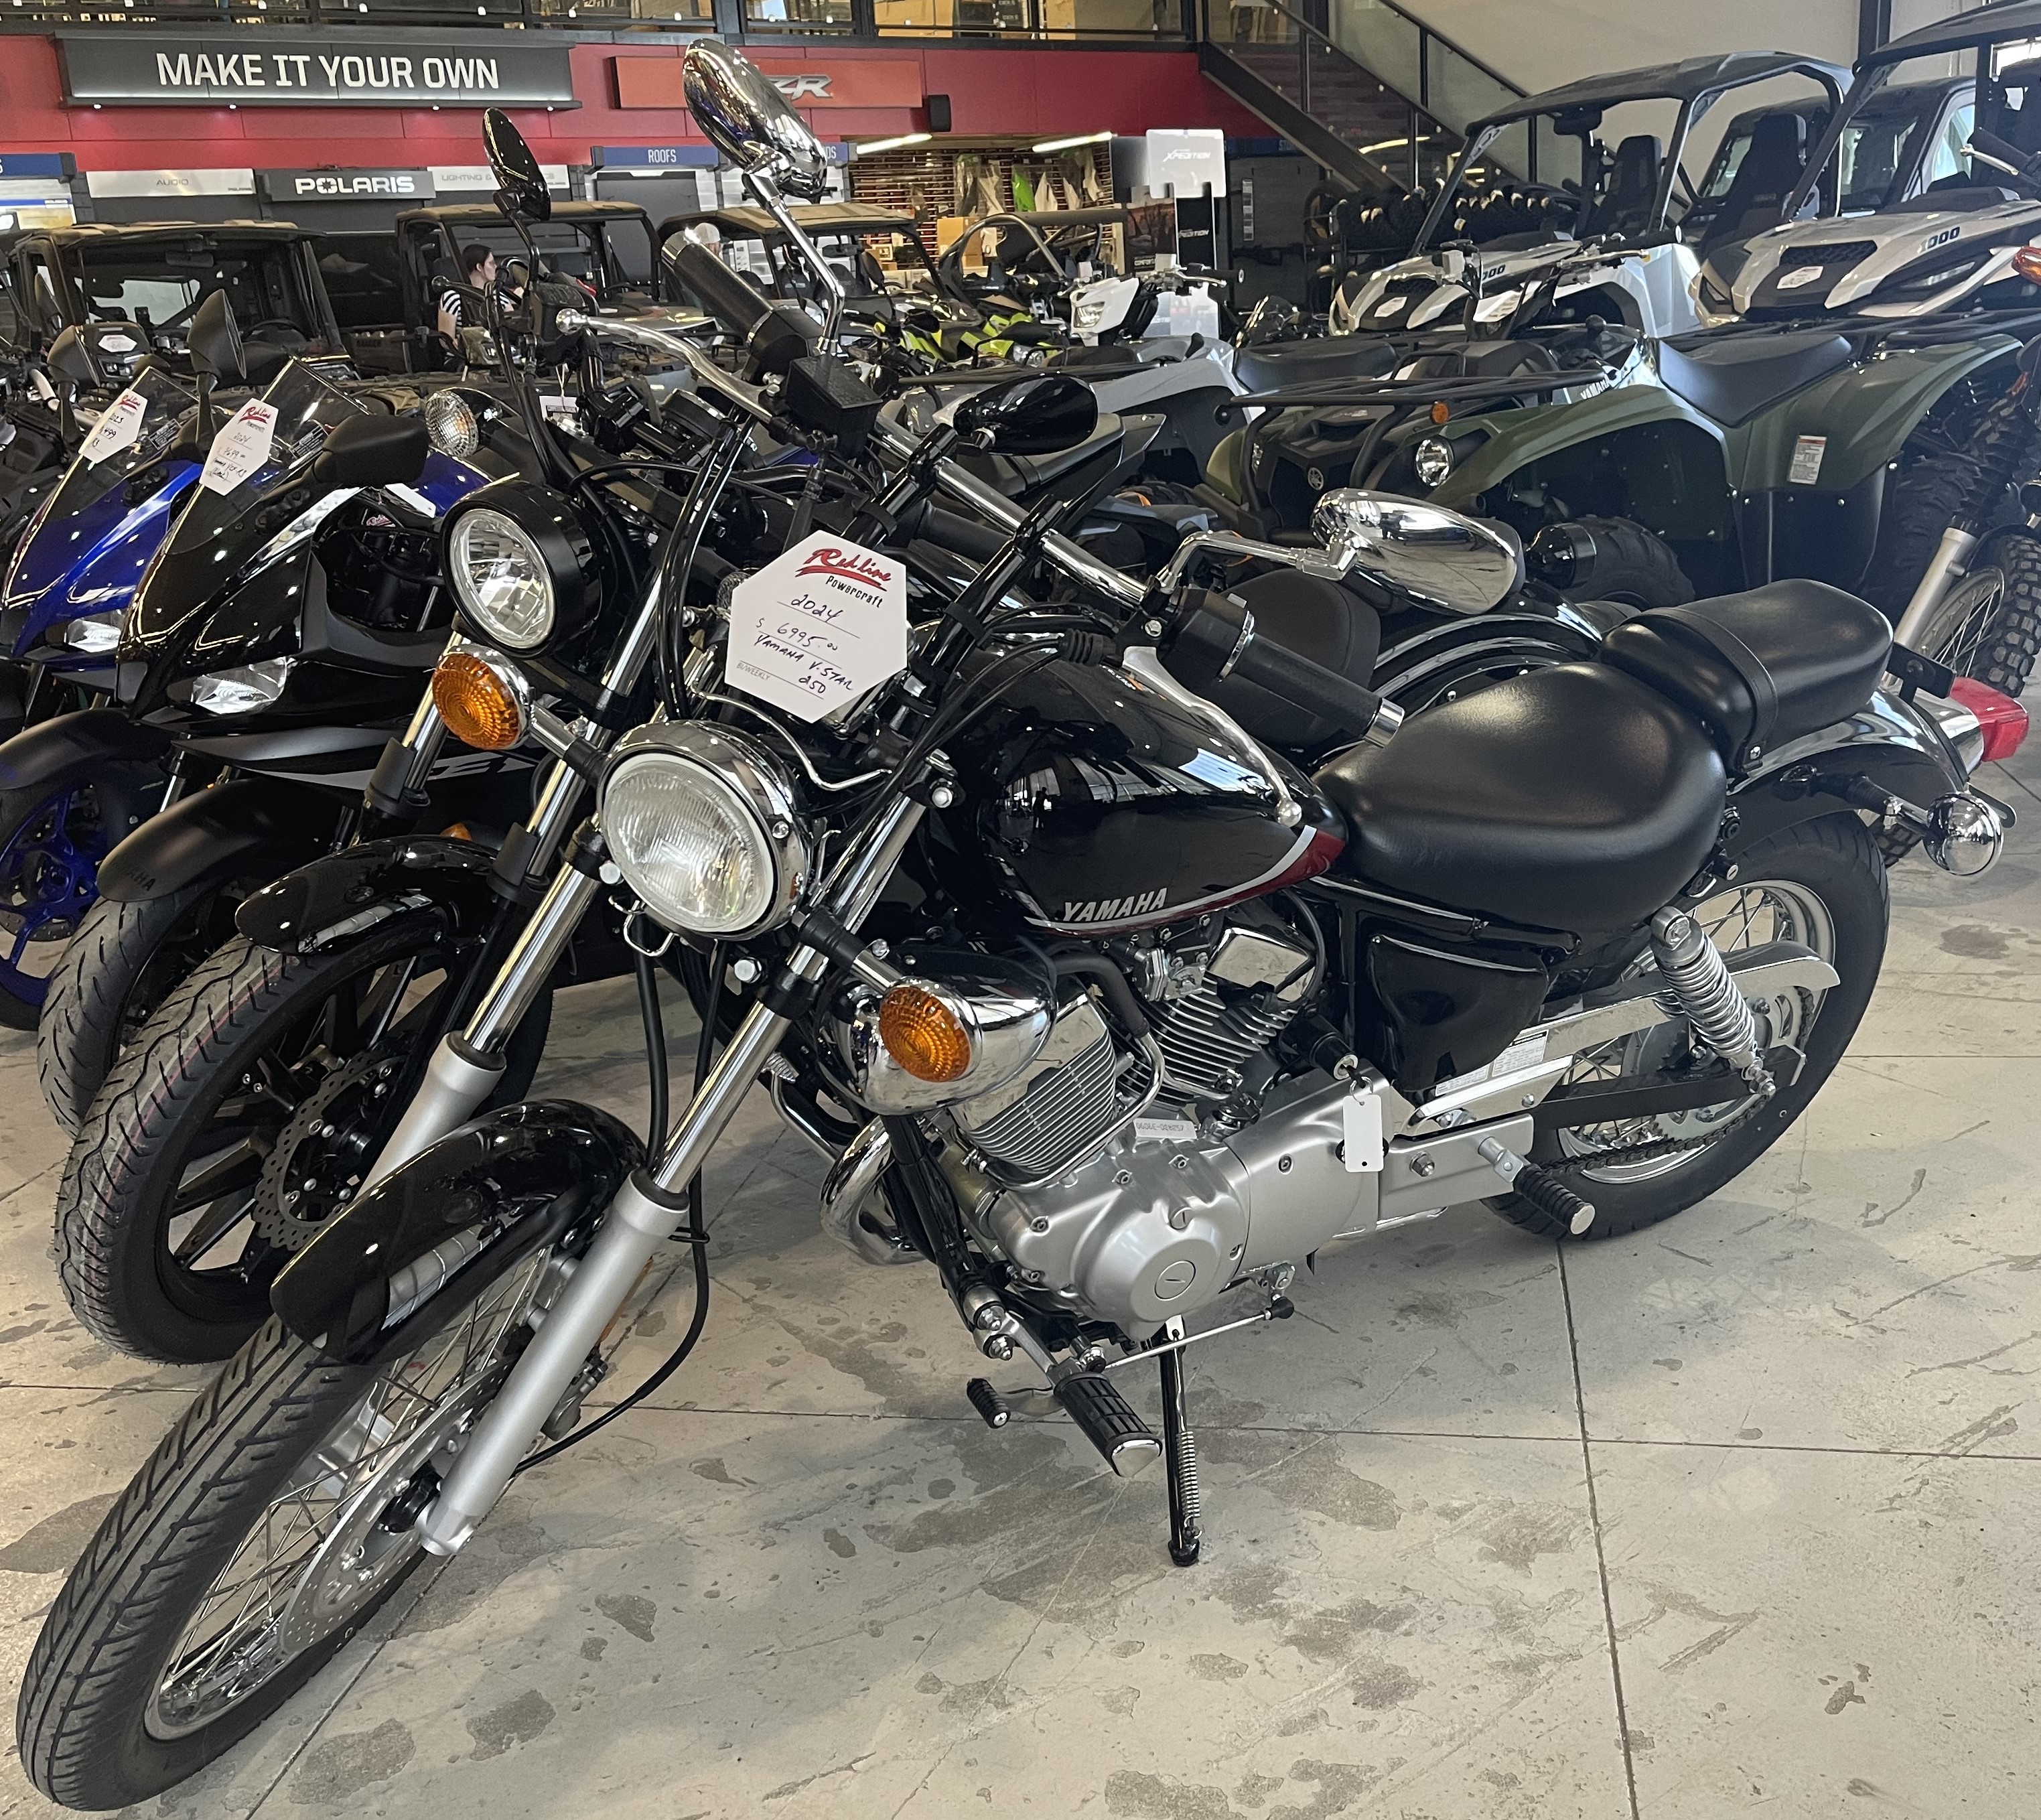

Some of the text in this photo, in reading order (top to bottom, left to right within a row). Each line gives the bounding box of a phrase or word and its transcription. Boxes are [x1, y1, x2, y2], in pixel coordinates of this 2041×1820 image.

[156, 53, 499, 88] MAKE IT YOUR OWN
[648, 149, 677, 163] ROOFS
[295, 176, 415, 194] POLARIS
[802, 548, 892, 581] Redline
[825, 575, 884, 608] Powercraft
[790, 593, 843, 623] 2024
[798, 675, 827, 694] 250
[1062, 887, 1168, 922] YAMAHA
